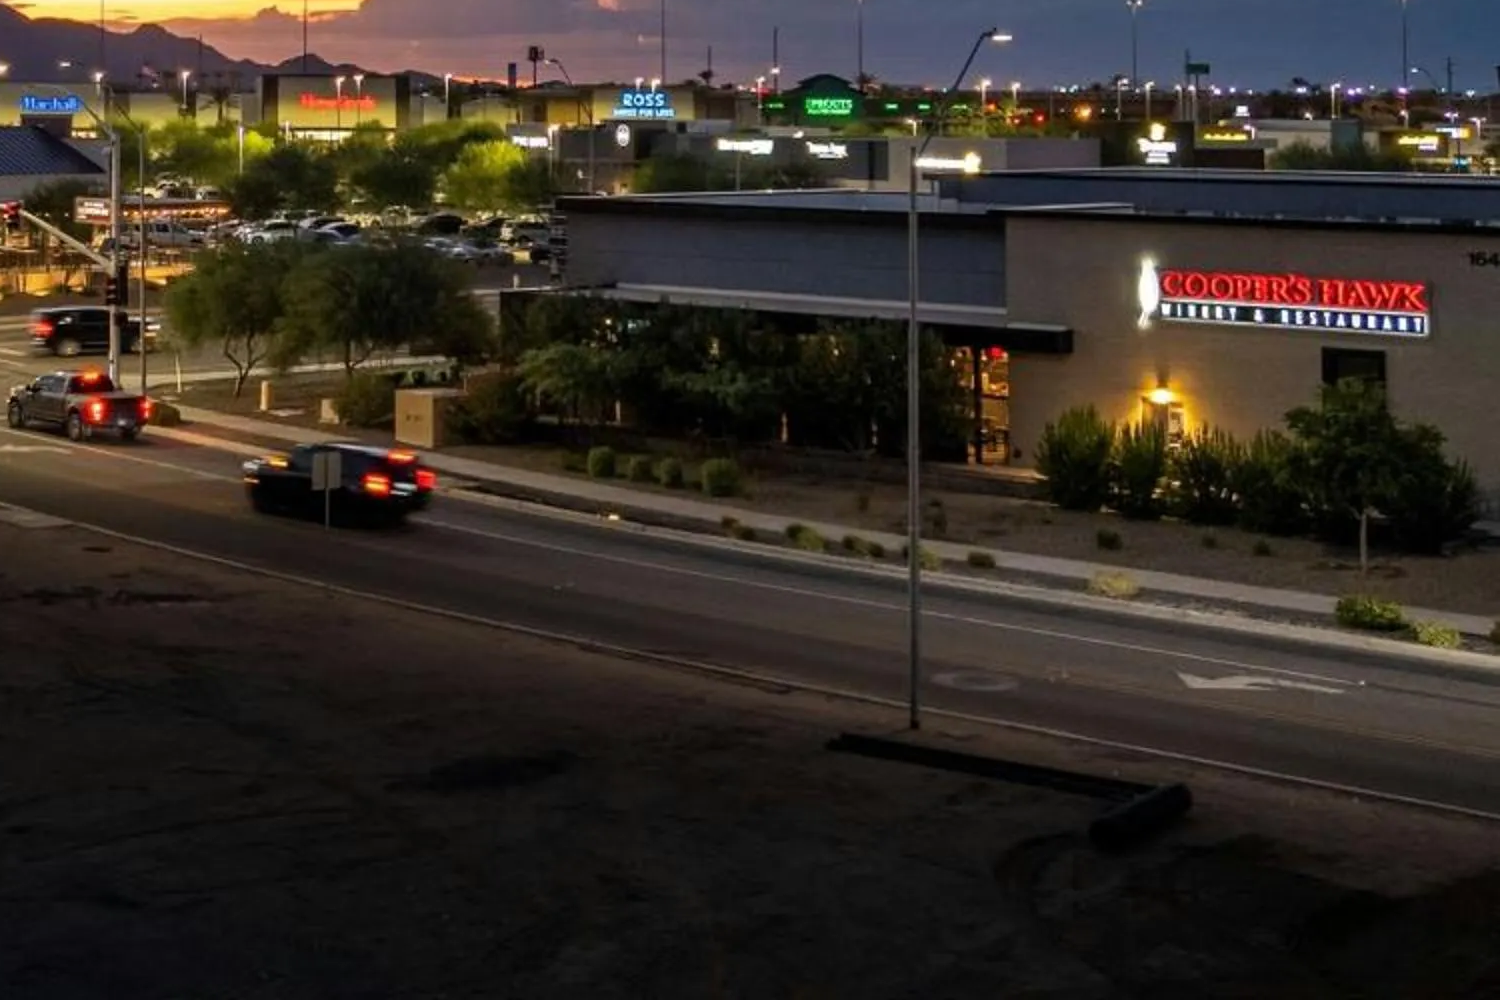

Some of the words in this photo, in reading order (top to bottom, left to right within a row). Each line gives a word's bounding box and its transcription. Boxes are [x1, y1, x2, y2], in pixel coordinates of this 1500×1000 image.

[622, 92, 665, 107] ROSS
[1162, 271, 1312, 304] COOPER'S
[1318, 279, 1427, 312] HAWK
[1161, 303, 1238, 322] WINERY
[1253, 309, 1264, 324] &
[1281, 311, 1423, 333] RESTAURANT
